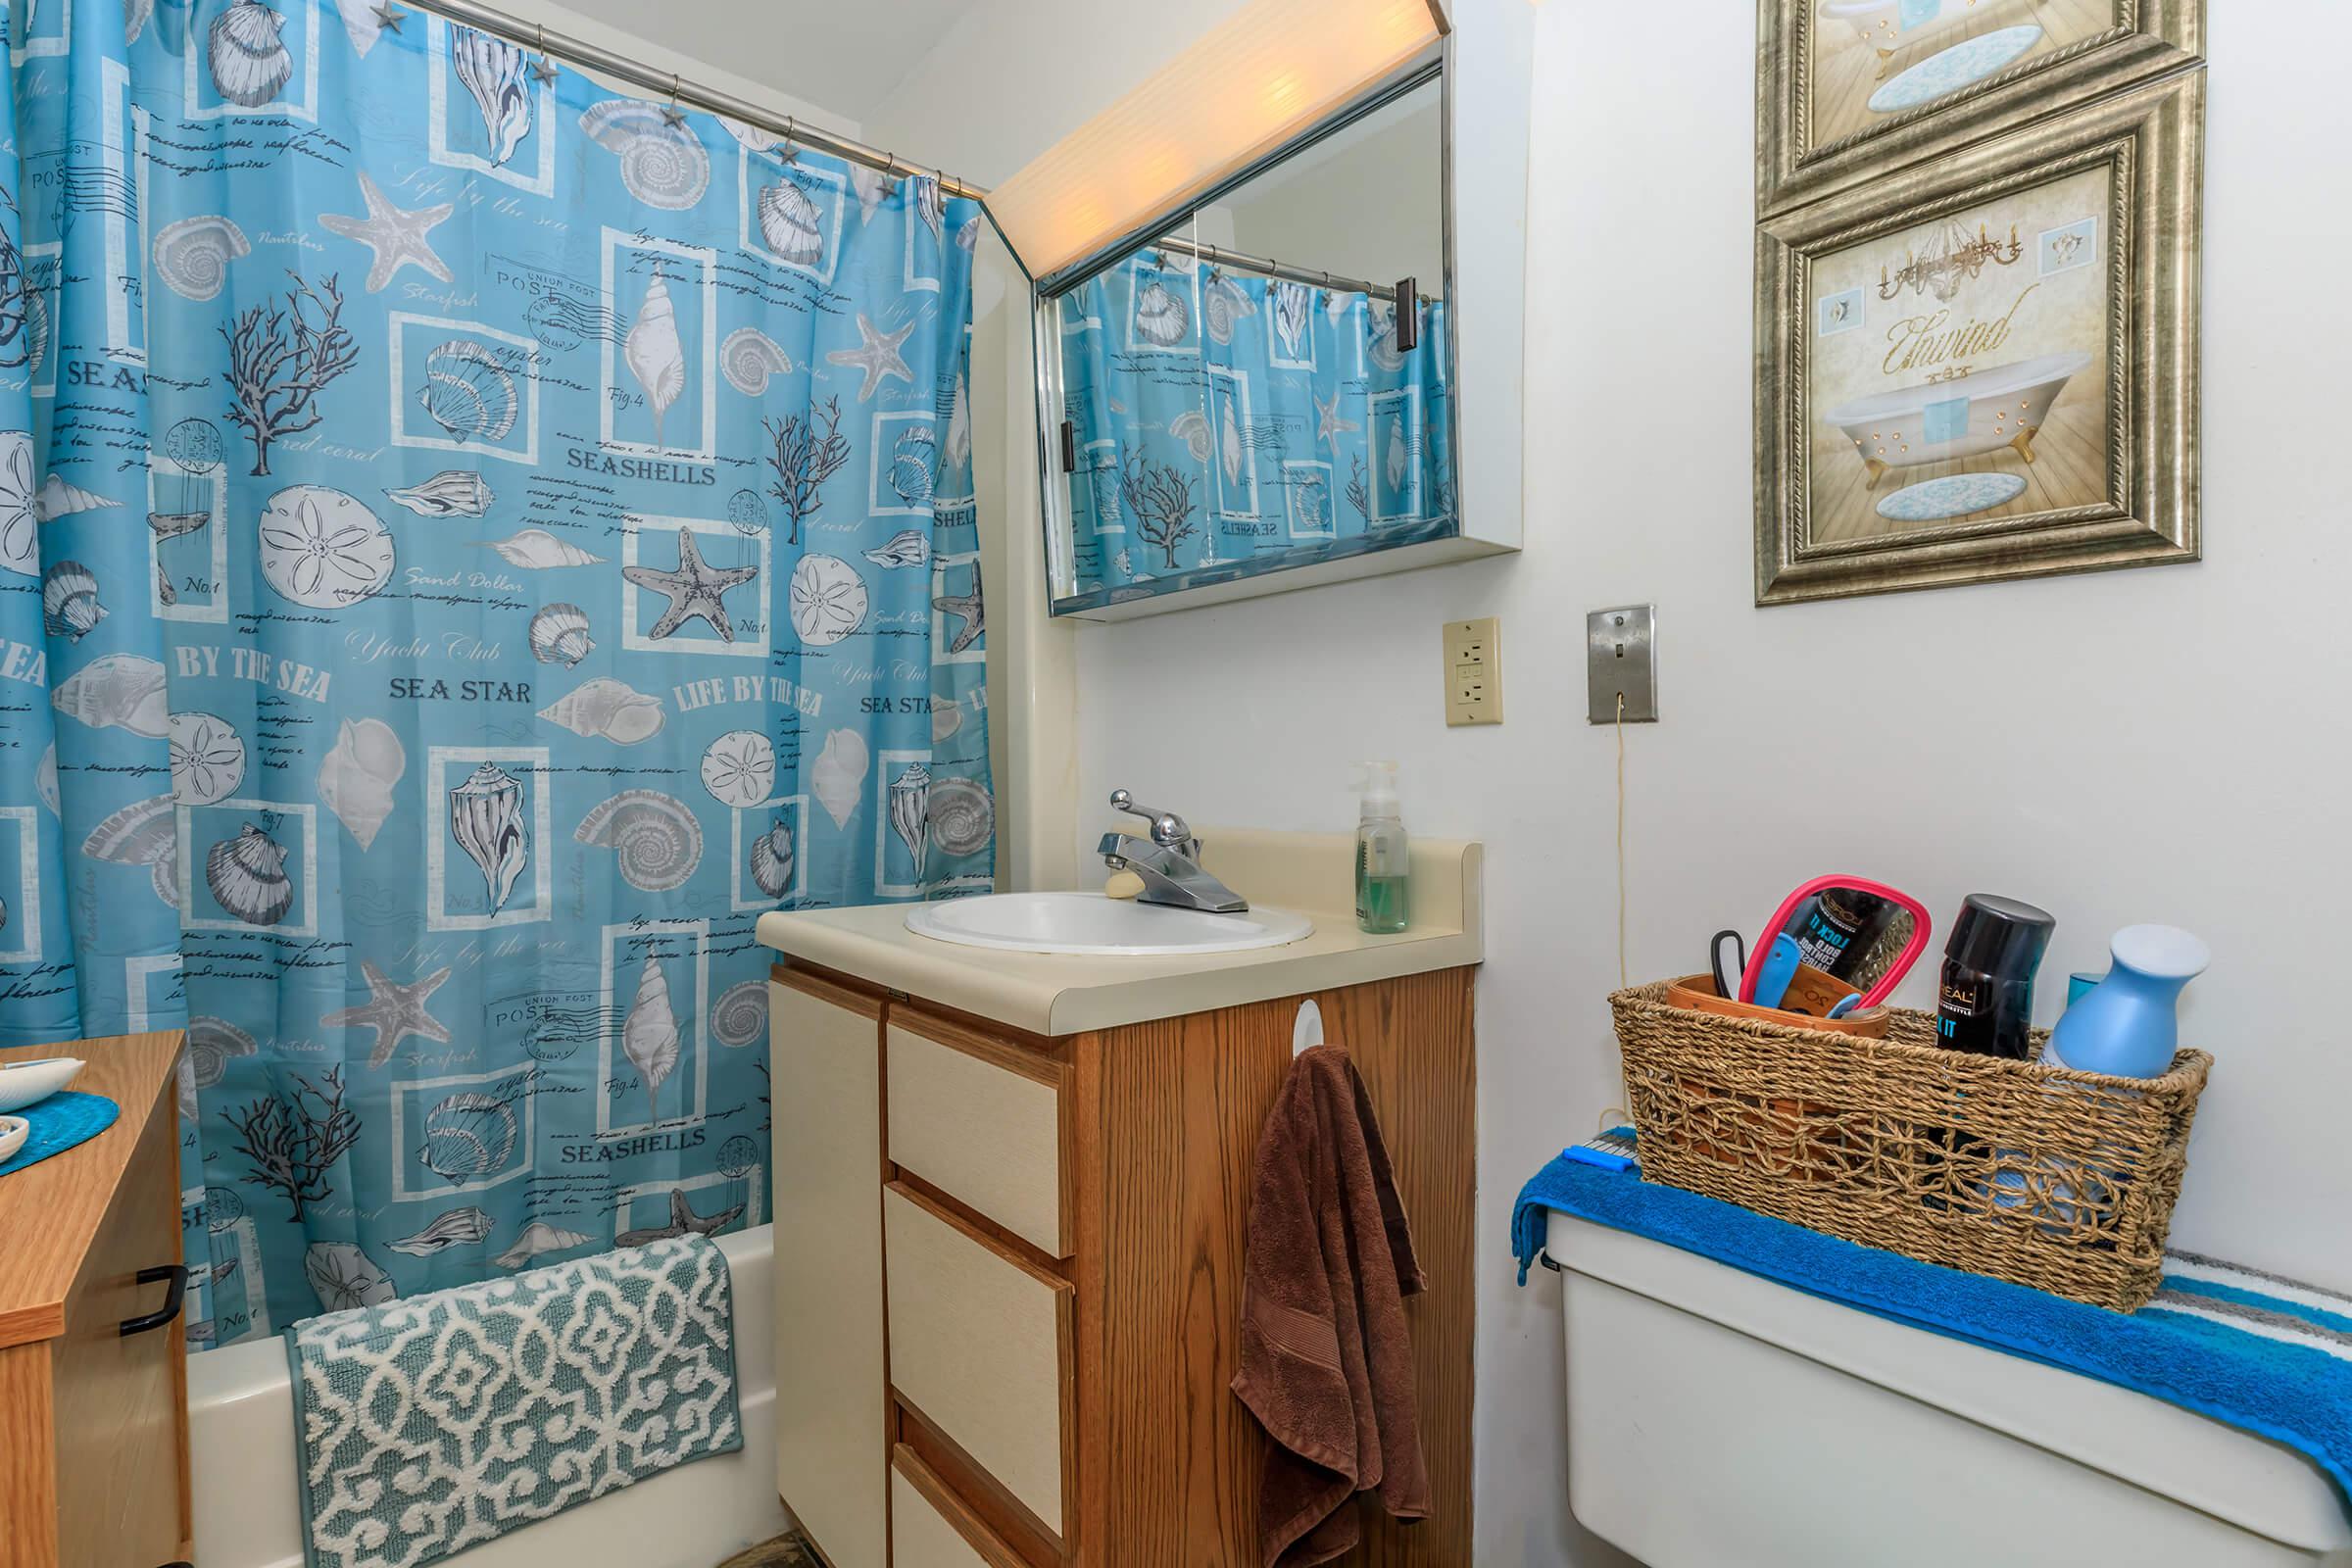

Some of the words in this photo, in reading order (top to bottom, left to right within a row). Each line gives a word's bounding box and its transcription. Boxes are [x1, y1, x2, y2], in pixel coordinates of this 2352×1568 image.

[493, 197, 524, 218] the
[402, 281, 479, 313] Starfish
[497, 270, 558, 302] POST
[1882, 282, 2041, 376] Unwind
[495, 346, 553, 368] oyster
[608, 386, 644, 411] Fig.4
[280, 434, 322, 454] red
[318, 444, 386, 464] coral
[566, 447, 716, 486] SEASHELLS
[183, 576, 220, 595] No.1
[404, 565, 462, 587] Sand
[467, 571, 525, 594] Dollar
[739, 618, 767, 635] No.1
[344, 628, 431, 665] Yacht
[441, 631, 502, 661] Club
[174, 645, 220, 676] BY
[231, 647, 272, 685] THE
[276, 659, 331, 705] SEA
[389, 677, 451, 700] SEA
[460, 679, 532, 704] STAR
[672, 677, 728, 712] LIFE
[732, 674, 766, 703] BY
[769, 676, 794, 706] THE
[794, 687, 824, 717] SEA
[860, 697, 893, 714] SEA
[524, 996, 560, 1006] UNION
[496, 1004, 554, 1027] POST
[1944, 1018, 1957, 1039] IT
[495, 1067, 548, 1094] oyster
[604, 1076, 639, 1100] Fig.4
[560, 1127, 708, 1164] SEASHELLS
[222, 1307, 258, 1333] No.1
